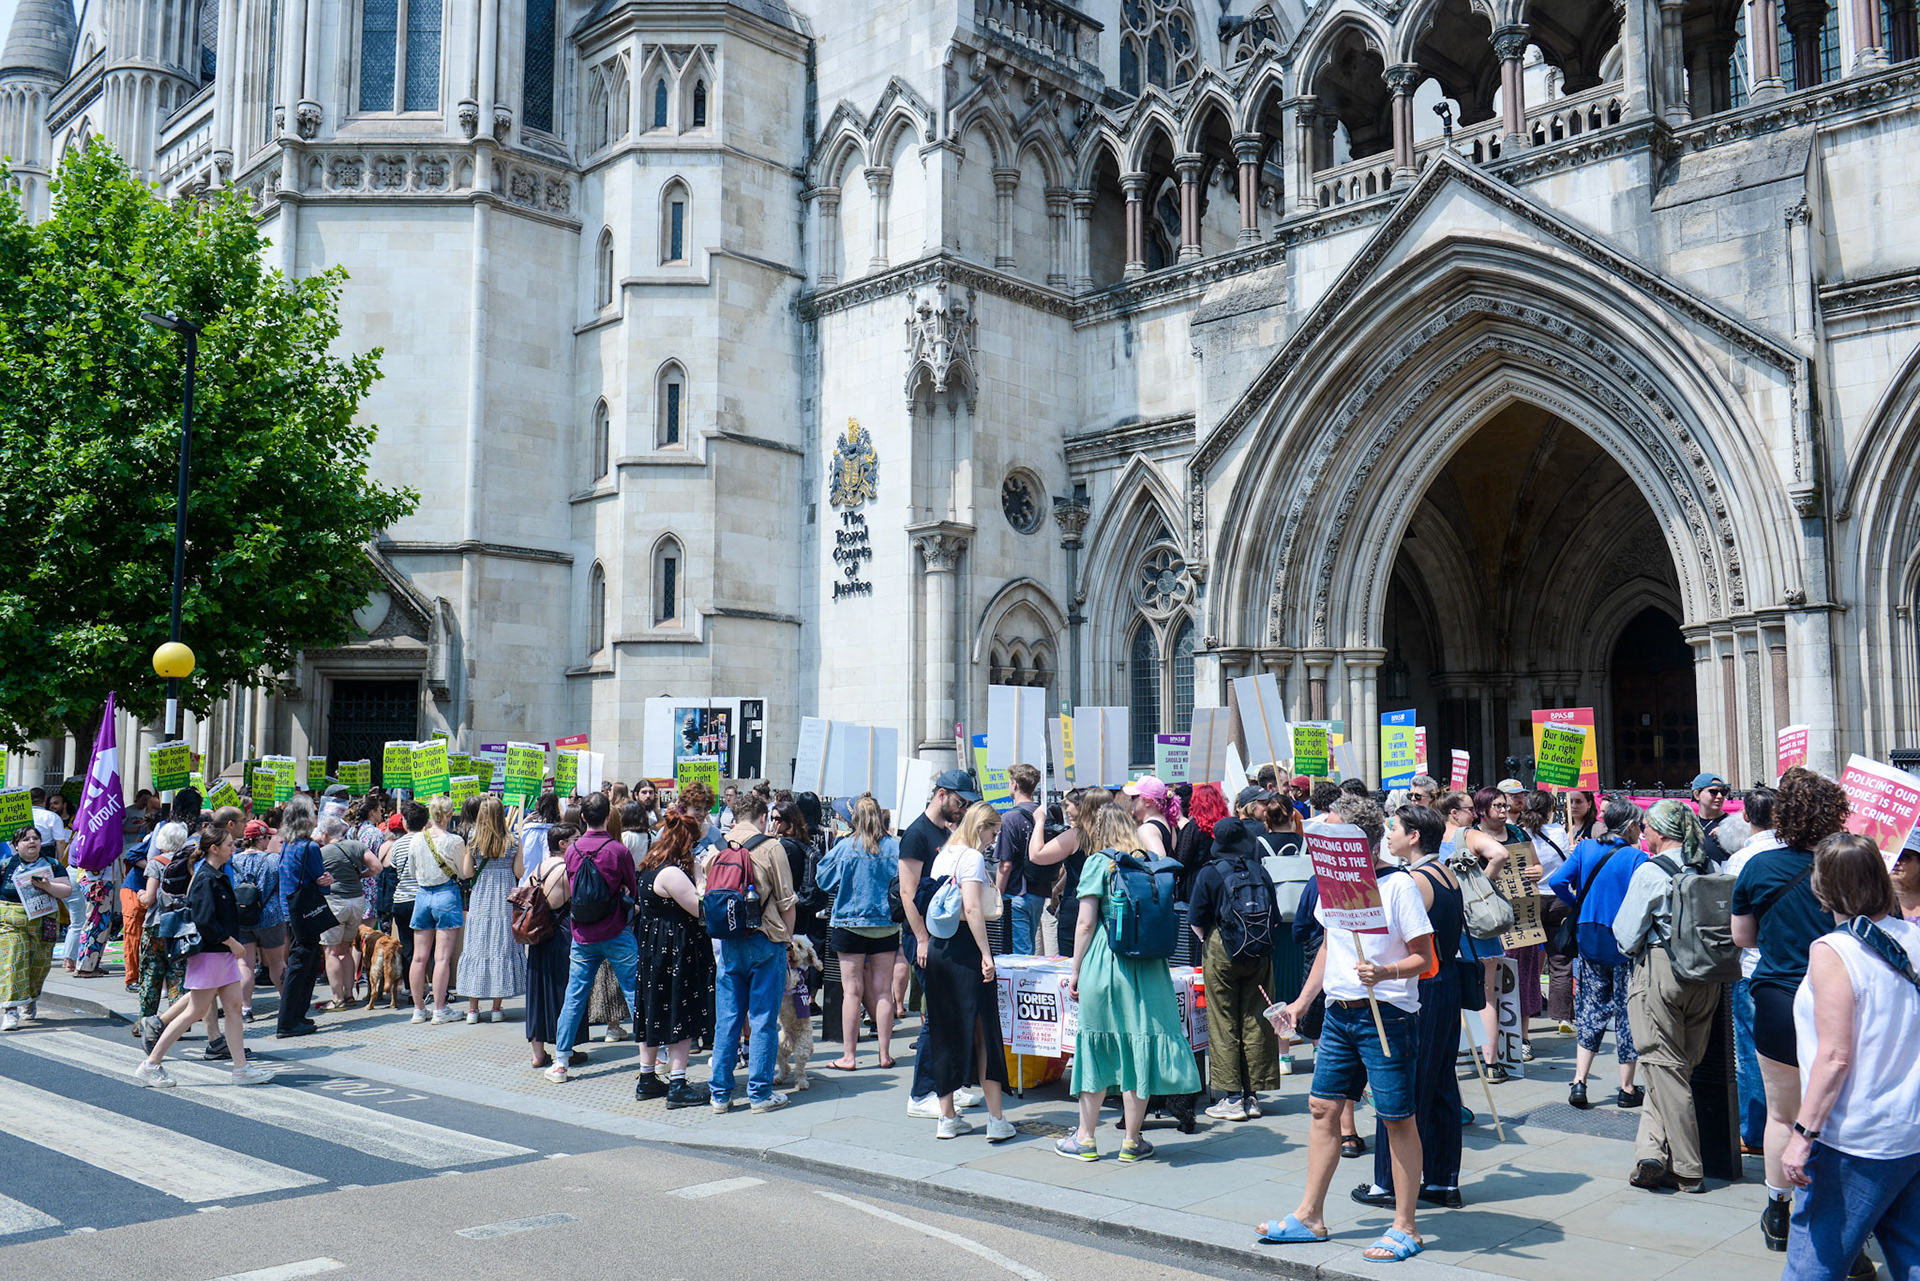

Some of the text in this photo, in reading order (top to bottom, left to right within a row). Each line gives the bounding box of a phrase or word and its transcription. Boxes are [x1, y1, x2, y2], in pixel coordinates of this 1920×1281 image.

[841, 511, 865, 526] The
[835, 525, 869, 546] Royal
[832, 546, 872, 562] Courts
[844, 561, 859, 577] of
[832, 578, 873, 599] Justice
[1295, 728, 1325, 737] Our bodies
[1392, 732, 1404, 740] LISTEN
[1544, 729, 1583, 744] Our bodies
[1295, 738, 1321, 749] Our right
[1780, 735, 1796, 745] POLICING
[170, 747, 189, 755] bodies
[1304, 748, 1322, 756] decide
[1542, 740, 1576, 756] Our right
[1780, 744, 1791, 752] BODIES
[412, 747, 445, 760] Our bodies
[508, 748, 520, 757] Our
[522, 750, 543, 760] bodies
[1541, 752, 1575, 765] to decide
[1779, 752, 1788, 760] REAL
[170, 756, 184, 766] right
[398, 756, 411, 764] right
[413, 758, 441, 769] Our right
[508, 758, 520, 766] Our
[522, 759, 537, 769] right
[559, 755, 569, 763] Our
[1384, 759, 1413, 768] CRIMINALISATION
[1581, 759, 1593, 767] HTS
[166, 765, 185, 773] decide
[275, 761, 294, 770] bodies
[558, 764, 577, 773] Our rig
[680, 763, 716, 772] Our bodies
[1539, 763, 1554, 771] Defend
[276, 770, 289, 779] right
[424, 766, 443, 776] decide
[517, 767, 537, 777] decide
[680, 774, 711, 783] Our right
[261, 783, 273, 791] right
[983, 782, 1009, 791] CRIMINALISAT
[1846, 771, 1919, 804] POLICING OUR
[5, 793, 29, 803] bodies
[1842, 784, 1913, 818] BODIES IS THE
[8, 803, 25, 814] right
[1848, 802, 1858, 813] AL
[4, 814, 27, 823] decide
[88, 794, 122, 833] about
[1308, 837, 1363, 853] POLICING OUR
[1312, 851, 1368, 867] BODIES IS THE
[1316, 866, 1361, 882] REAL CRIME
[727, 899, 737, 931] VANS
[1526, 901, 1538, 928] LEGAL
[1017, 992, 1055, 1005] TORIES
[1018, 1003, 1056, 1021] OUT!
